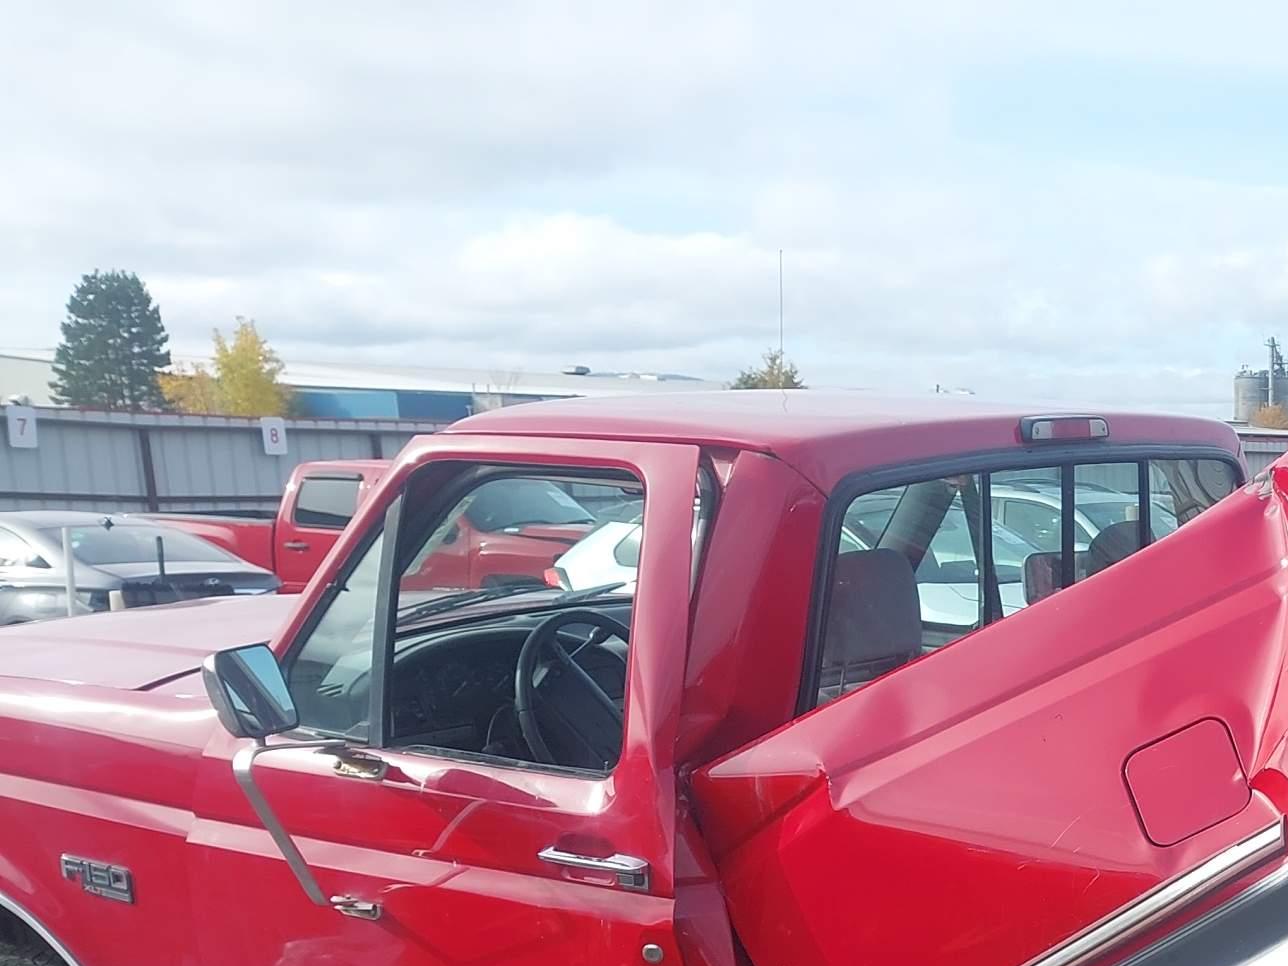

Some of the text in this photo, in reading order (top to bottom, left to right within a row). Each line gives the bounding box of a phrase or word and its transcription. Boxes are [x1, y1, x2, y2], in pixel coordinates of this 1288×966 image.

[16, 418, 27, 436] 7
[270, 427, 280, 444] 8
[61, 853, 129, 891] F150
